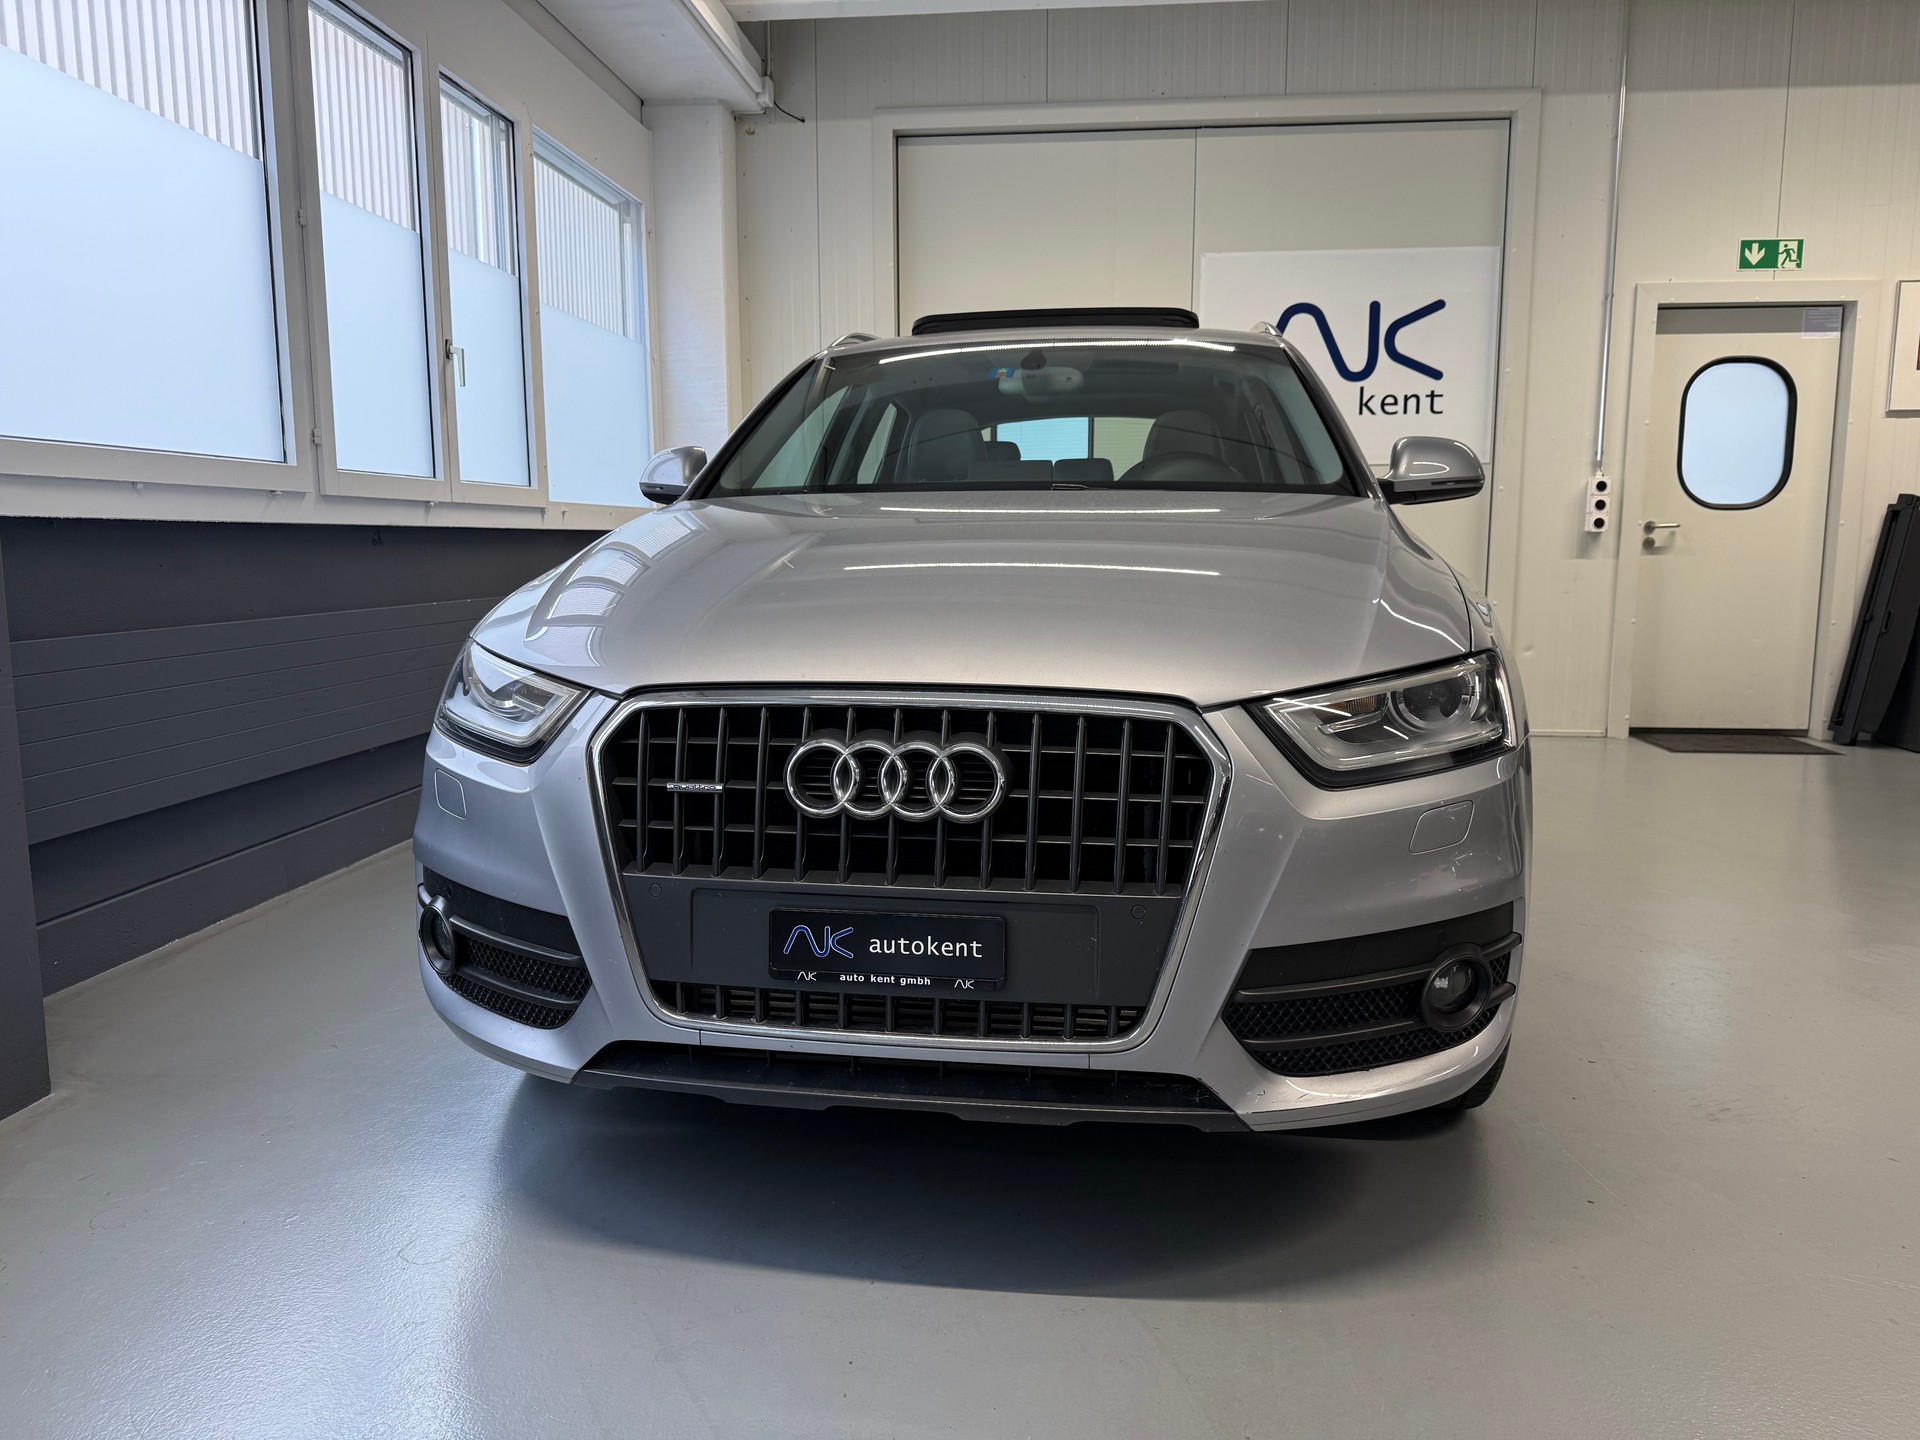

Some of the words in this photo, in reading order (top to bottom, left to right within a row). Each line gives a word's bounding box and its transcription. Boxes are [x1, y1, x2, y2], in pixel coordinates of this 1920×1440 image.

[1358, 386, 1444, 416] kent
[869, 935, 983, 958] autokent
[839, 973, 865, 982] auto
[870, 974, 896, 984] kent
[900, 976, 931, 986] gmbh
